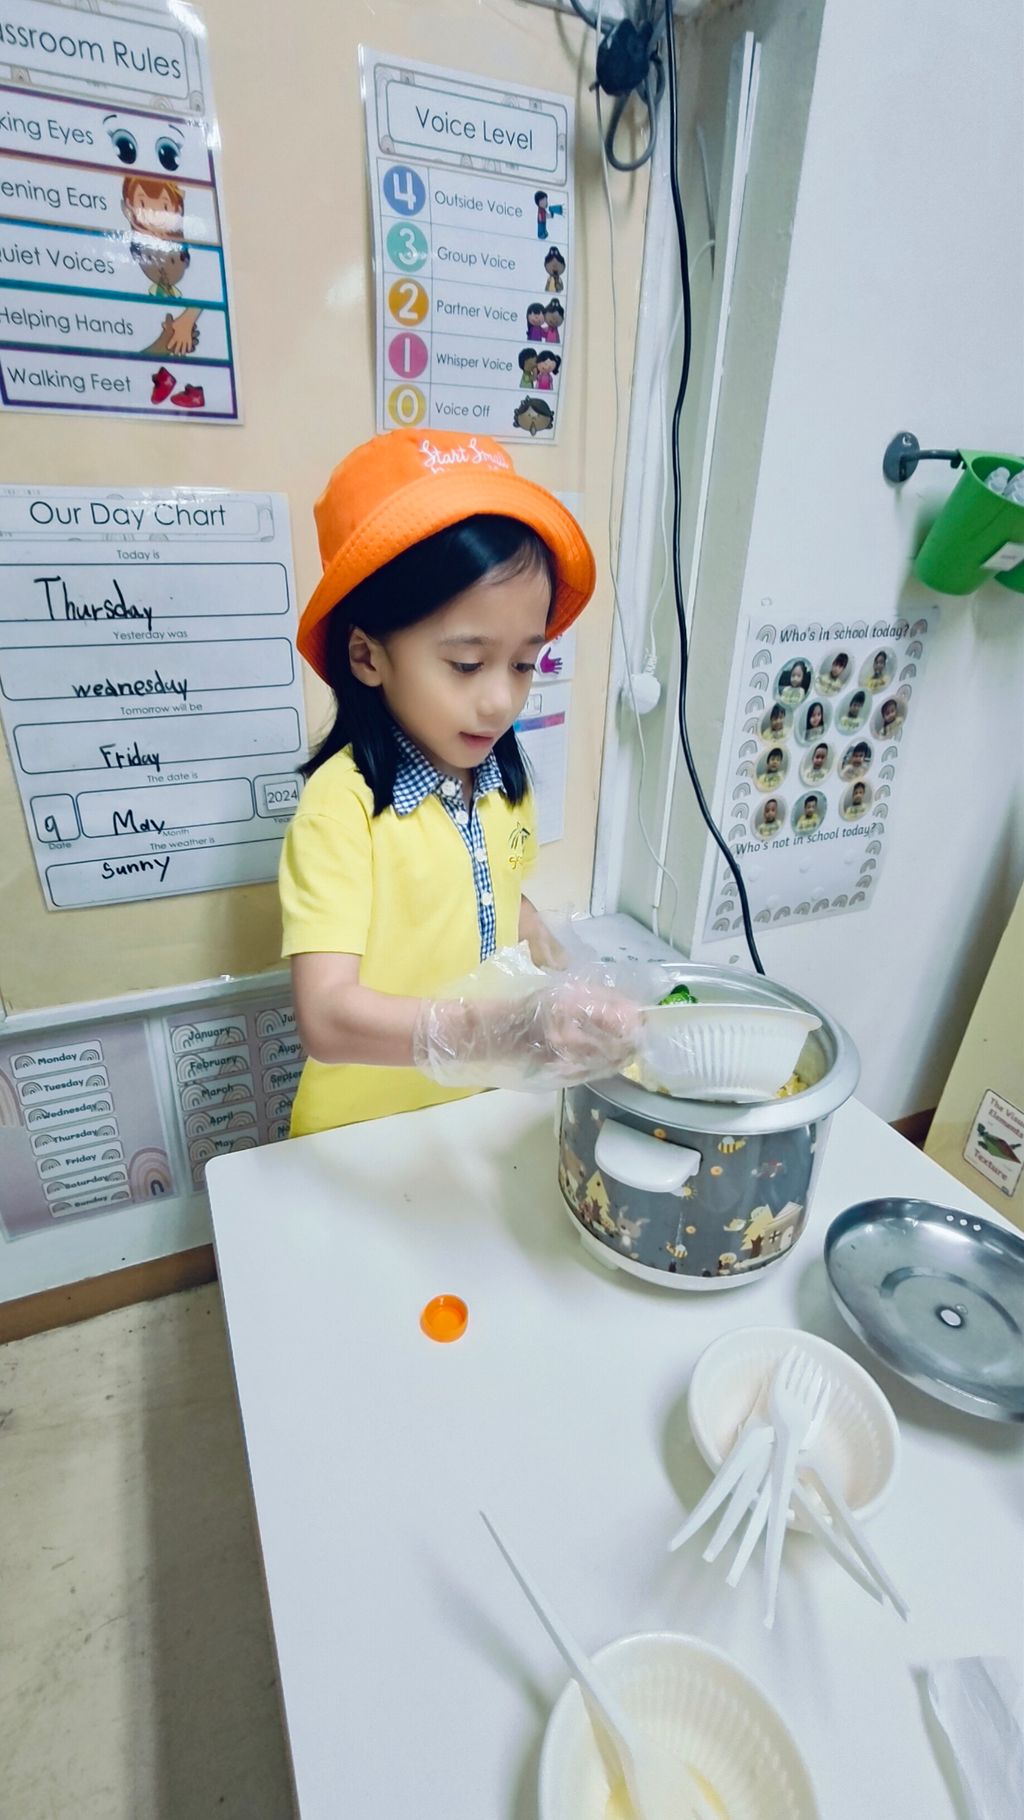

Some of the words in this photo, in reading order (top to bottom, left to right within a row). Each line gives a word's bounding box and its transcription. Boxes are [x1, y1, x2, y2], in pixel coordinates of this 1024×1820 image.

[0, 22, 104, 63] ssroom
[113, 41, 181, 79] Rules
[47, 119, 94, 145] Eyes
[415, 105, 475, 139] Voice
[483, 120, 533, 150] Level
[0, 180, 61, 208] ening
[66, 187, 108, 211] Ears
[393, 172, 417, 210] 4
[434, 190, 483, 211] Outside
[487, 200, 523, 217] Voice
[398, 227, 419, 265] 3
[47, 249, 115, 274] Voices
[437, 246, 477, 265] Group
[480, 253, 516, 270] Voice
[400, 282, 418, 320] 2
[436, 300, 480, 318] Partner
[484, 306, 518, 322] Voice
[0, 306, 71, 334] Helping
[75, 313, 134, 336] Hands
[403, 337, 412, 374] 1
[436, 353, 479, 373] Whisper
[482, 359, 513, 372] Voice
[7, 367, 87, 394] Walking
[91, 377, 131, 393] Feet
[396, 388, 419, 423] 0
[435, 402, 469, 417] Voice
[472, 404, 490, 417] Off
[419, 440, 468, 468] Start
[30, 501, 80, 525] Our
[90, 502, 144, 530] Day
[154, 503, 226, 526] Chart
[117, 549, 150, 560] Today
[152, 550, 160, 559] is
[33, 575, 153, 631] Thursday
[113, 630, 165, 641] Yesterday
[168, 629, 188, 638] was
[780, 626, 816, 643] Who's
[820, 627, 830, 640] in
[834, 623, 868, 639] school
[872, 621, 910, 638] today?
[120, 706, 171, 717] Tomorrow
[173, 703, 188, 713] will
[191, 703, 203, 711] be
[99, 742, 160, 772] Friday
[147, 775, 165, 783] The
[168, 772, 190, 782] date
[192, 772, 199, 780] is
[267, 789, 298, 804] 2024
[113, 809, 165, 836] May
[274, 817, 290, 825] Yea
[150, 841, 169, 852] The
[172, 837, 207, 850] weather
[209, 835, 215, 844] is
[162, 829, 189, 838] Month
[735, 841, 768, 856] Who's
[772, 840, 789, 850] not
[793, 836, 804, 846] in
[807, 831, 839, 844] school
[842, 822, 877, 839] today?
[48, 841, 72, 851] Date
[188, 1026, 231, 1042] January
[38, 1052, 77, 1066] Monday
[278, 1044, 302, 1057] Augu
[190, 1055, 239, 1072] February
[44, 1078, 84, 1093] Tuesday
[201, 1084, 234, 1098] March
[41, 1102, 98, 1120] Wednesday
[210, 1111, 234, 1126] April
[990, 1097, 1004, 1112] The
[1006, 1109, 1024, 1129] Visua
[987, 1108, 1024, 1139] Elements
[53, 1128, 98, 1144] Thursday
[215, 1139, 234, 1150] May
[65, 1153, 96, 1167] Friday
[974, 1148, 1008, 1181] Texture
[64, 1174, 108, 1190] Saturday
